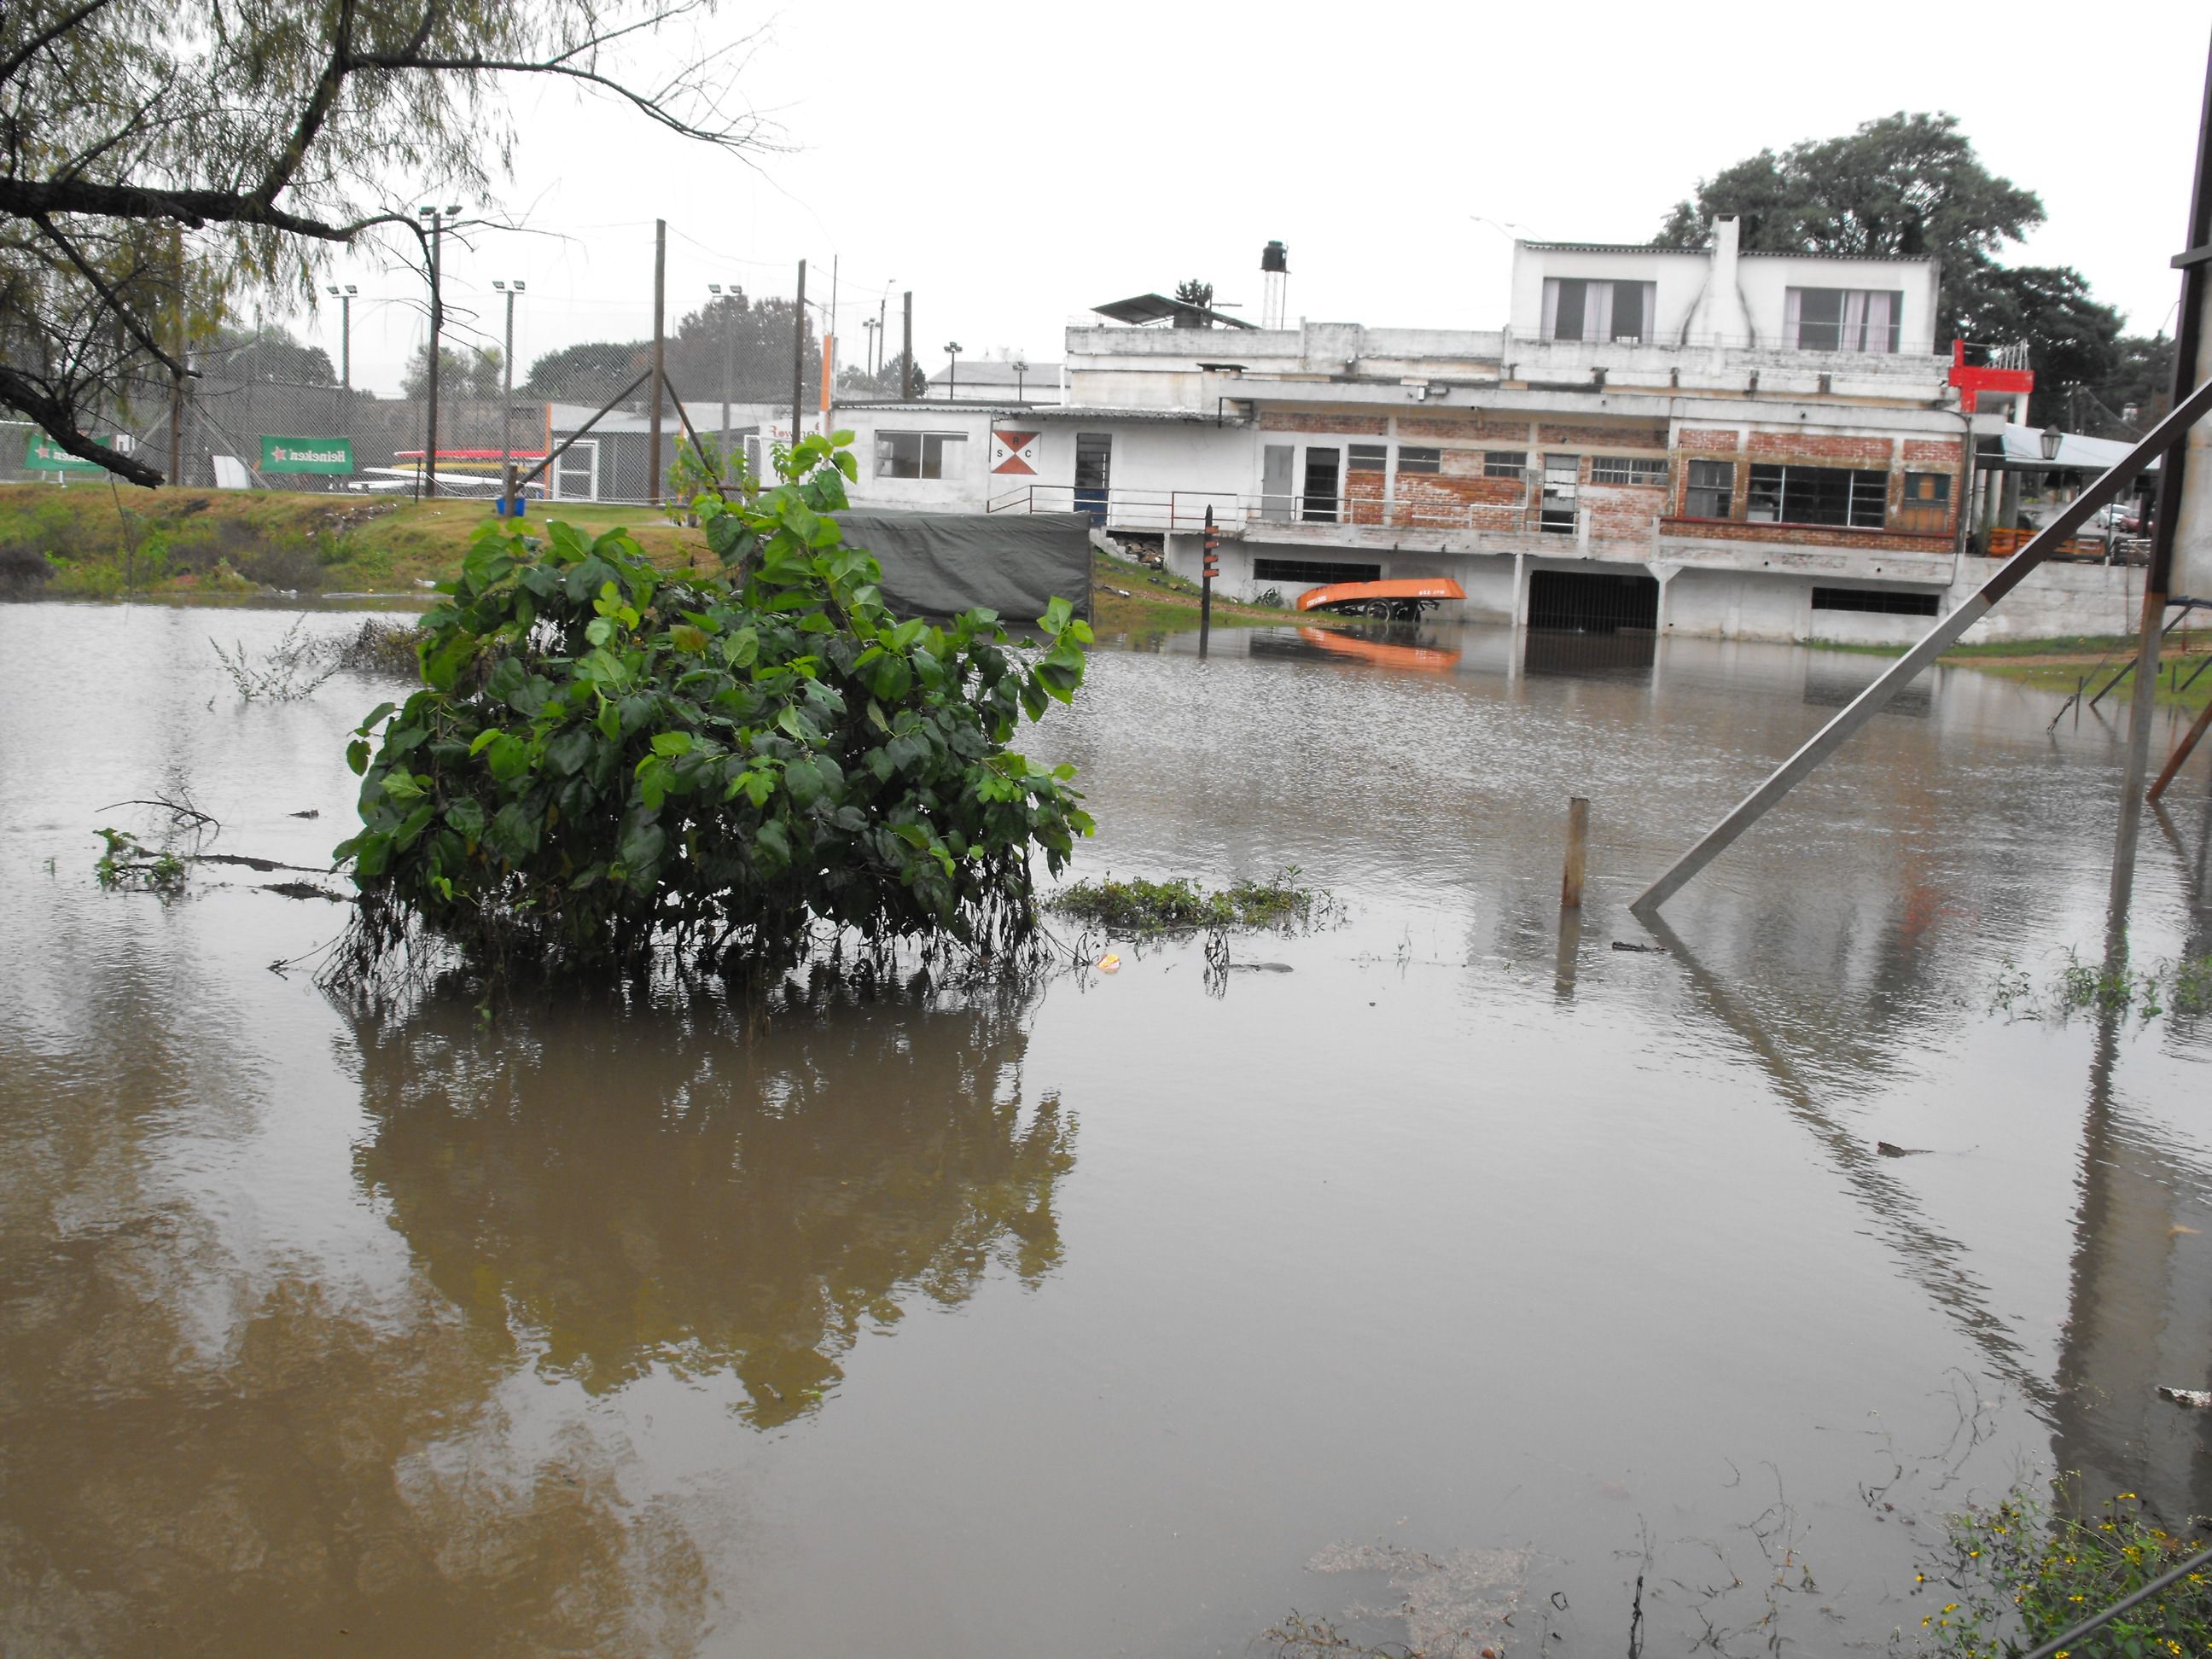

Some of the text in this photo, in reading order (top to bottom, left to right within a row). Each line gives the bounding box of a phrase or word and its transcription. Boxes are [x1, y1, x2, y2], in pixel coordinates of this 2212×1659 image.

[769, 425, 815, 438] Rowng
[1012, 436, 1020, 445] R
[997, 449, 1032, 457] S C
